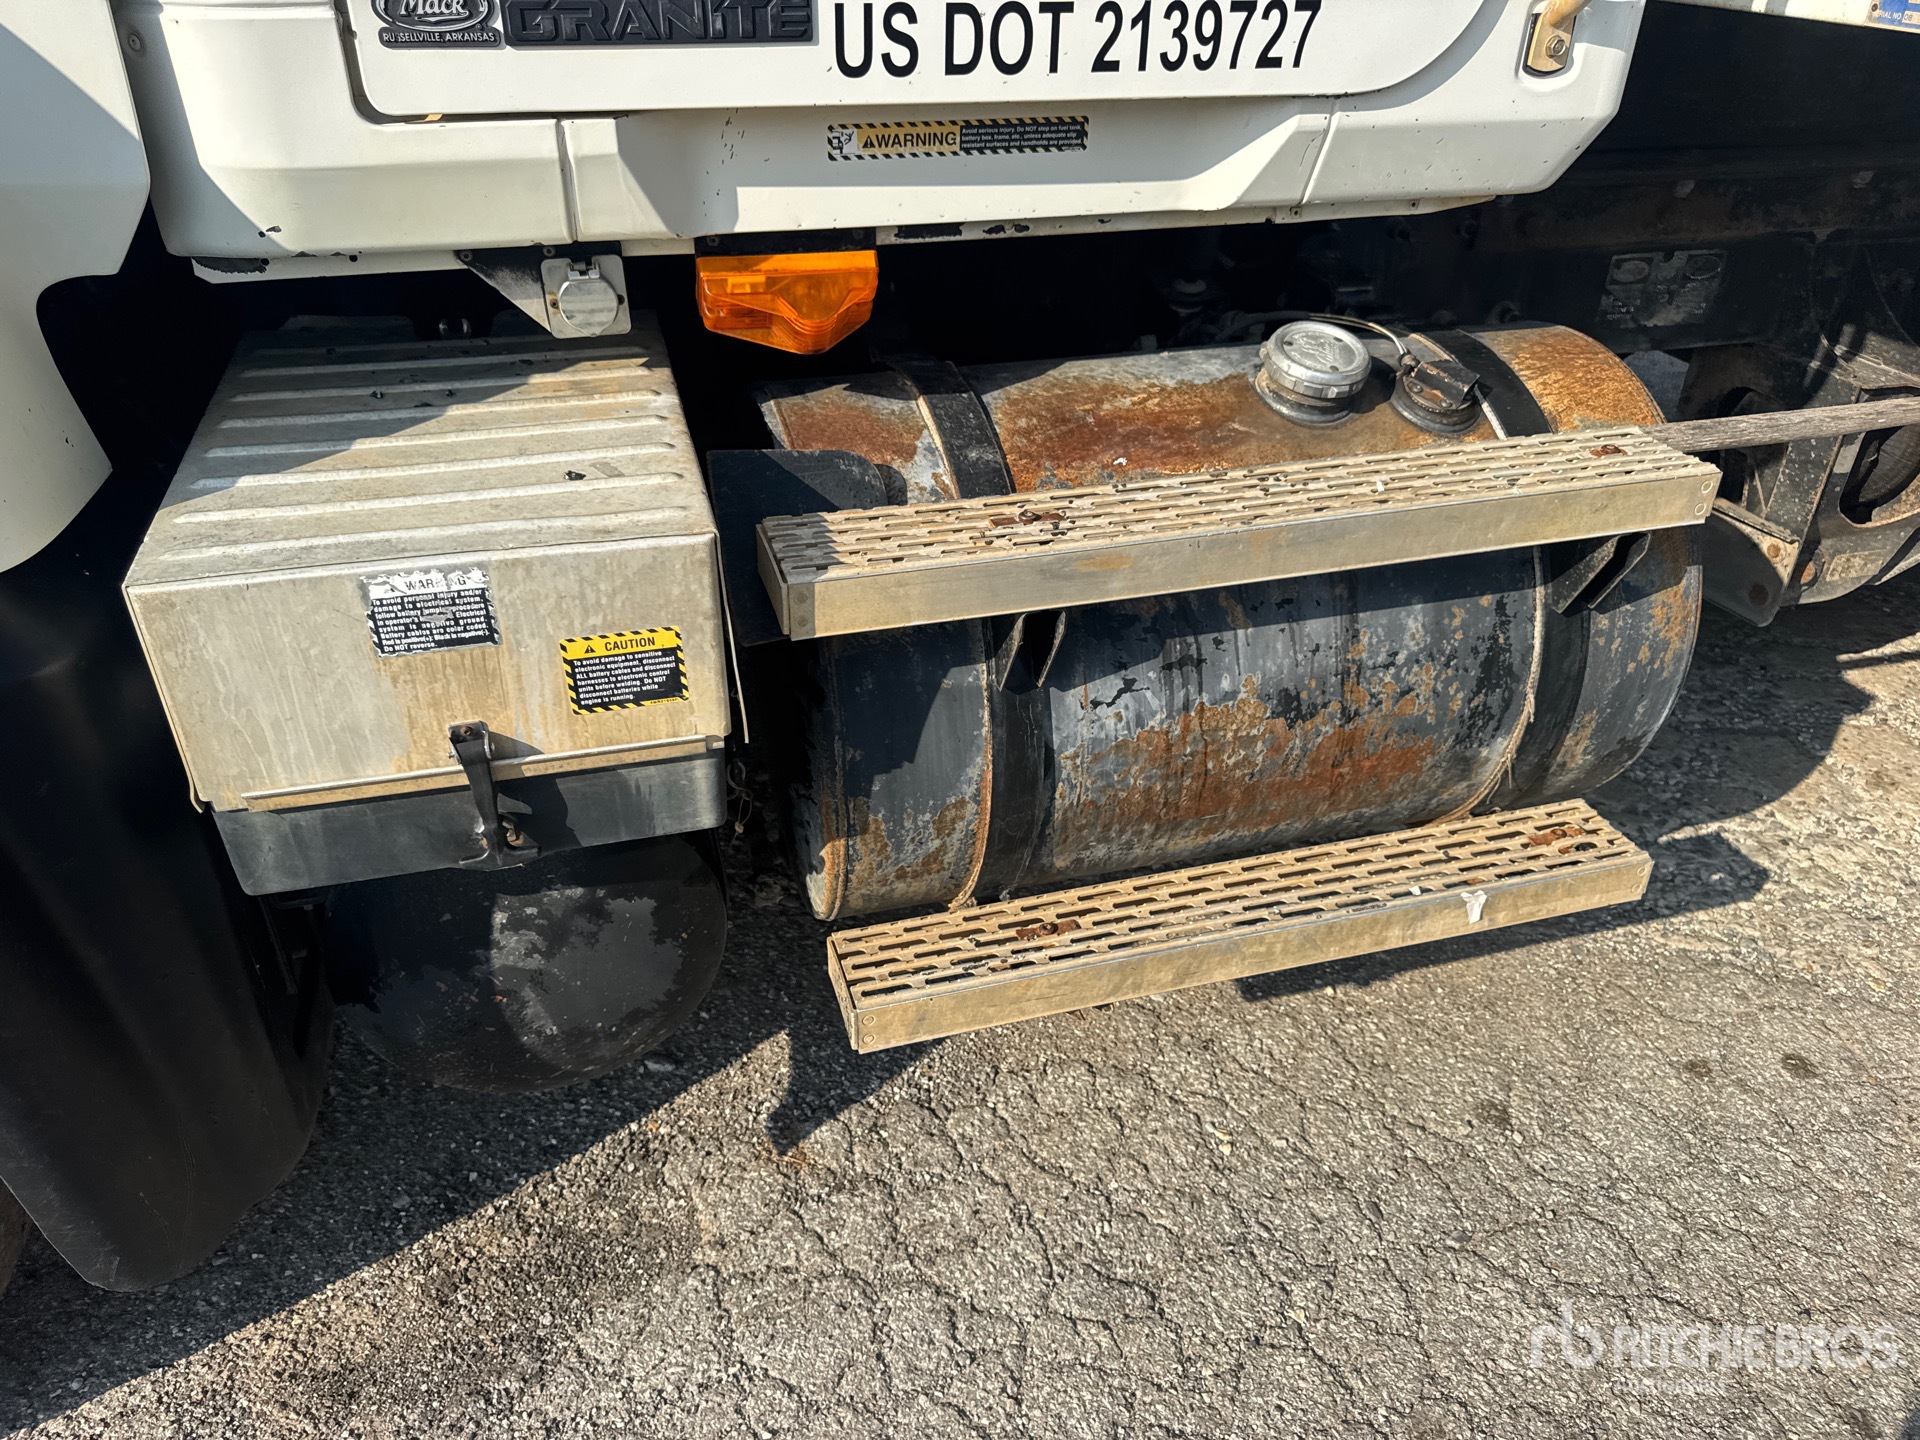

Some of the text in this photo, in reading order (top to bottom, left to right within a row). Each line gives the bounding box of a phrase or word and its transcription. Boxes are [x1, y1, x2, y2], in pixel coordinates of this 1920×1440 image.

[399, 0, 467, 16] Mack
[507, 0, 811, 41] GRANITE
[445, 32, 495, 42] ARKANSAS
[834, 0, 1323, 78] US DOT 2139727
[875, 131, 957, 149] WARNING
[404, 576, 467, 591] WARG
[460, 589, 482, 597] and/or
[374, 604, 402, 613] damage
[416, 599, 453, 608] electrical
[397, 609, 421, 618] battery
[455, 609, 486, 618] Electrical
[378, 625, 405, 633] system
[380, 632, 405, 640] Battery
[604, 637, 656, 651] CAUTION
[574, 664, 606, 673] electronic
[642, 656, 675, 664] disconnect
[601, 655, 626, 664] damage
[634, 651, 662, 659] sensitive
[577, 677, 608, 686] harnesses
[617, 672, 647, 681] electronic
[649, 669, 670, 677] control
[589, 670, 610, 679] battery
[644, 662, 676, 671] disconnect
[579, 690, 613, 699] disconnect
[614, 686, 641, 694] batteries
[581, 698, 602, 706] engine
